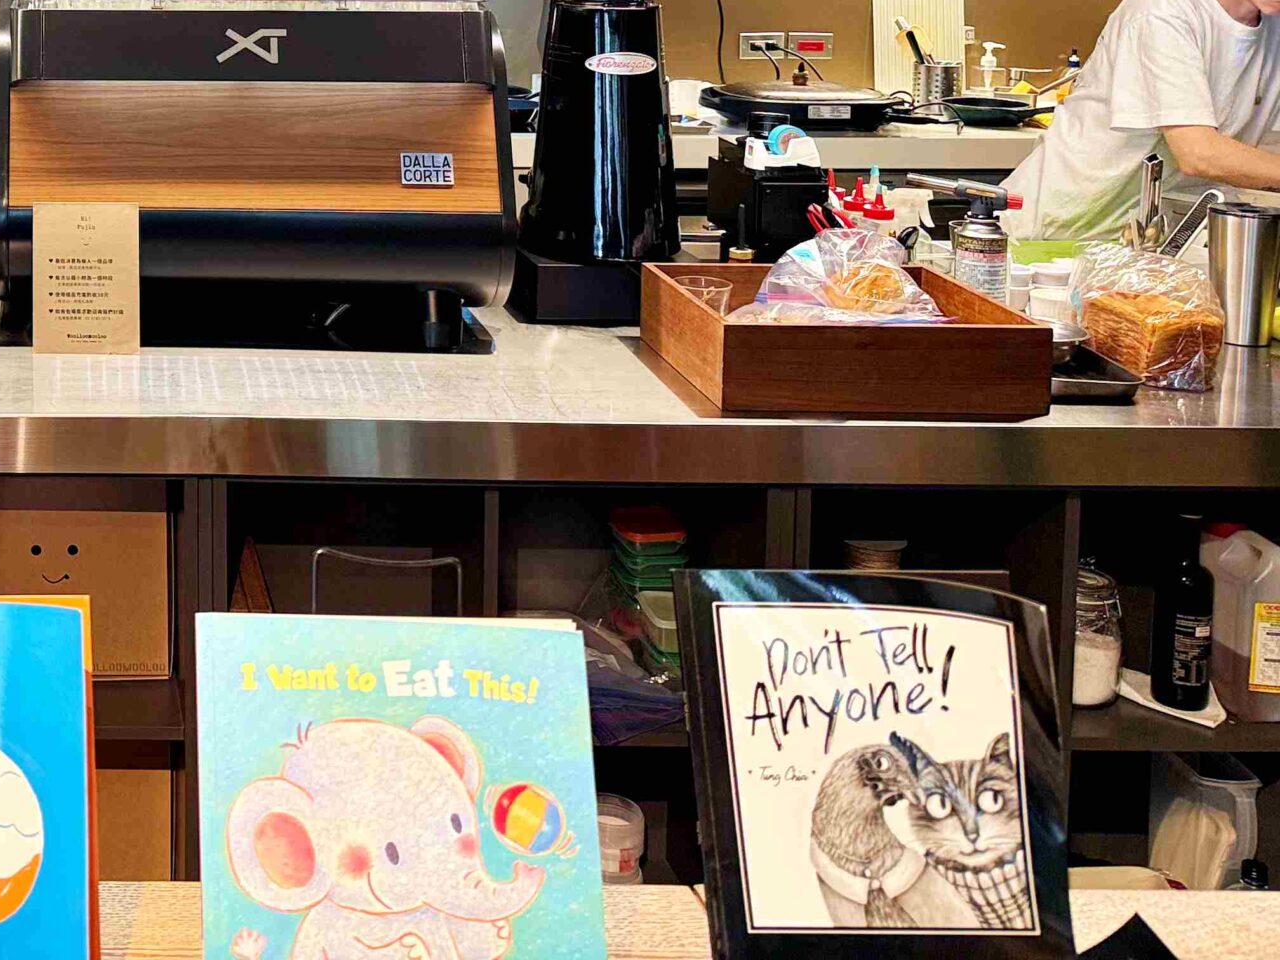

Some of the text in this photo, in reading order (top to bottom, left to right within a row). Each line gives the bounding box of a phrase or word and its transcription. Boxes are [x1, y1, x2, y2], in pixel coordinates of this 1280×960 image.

[402, 154, 451, 169] DALLA
[403, 169, 452, 183] CORTE
[763, 622, 934, 691] Don't Tell
[240, 659, 540, 705] I Want to Eat This!
[745, 645, 956, 755] Anyone!
